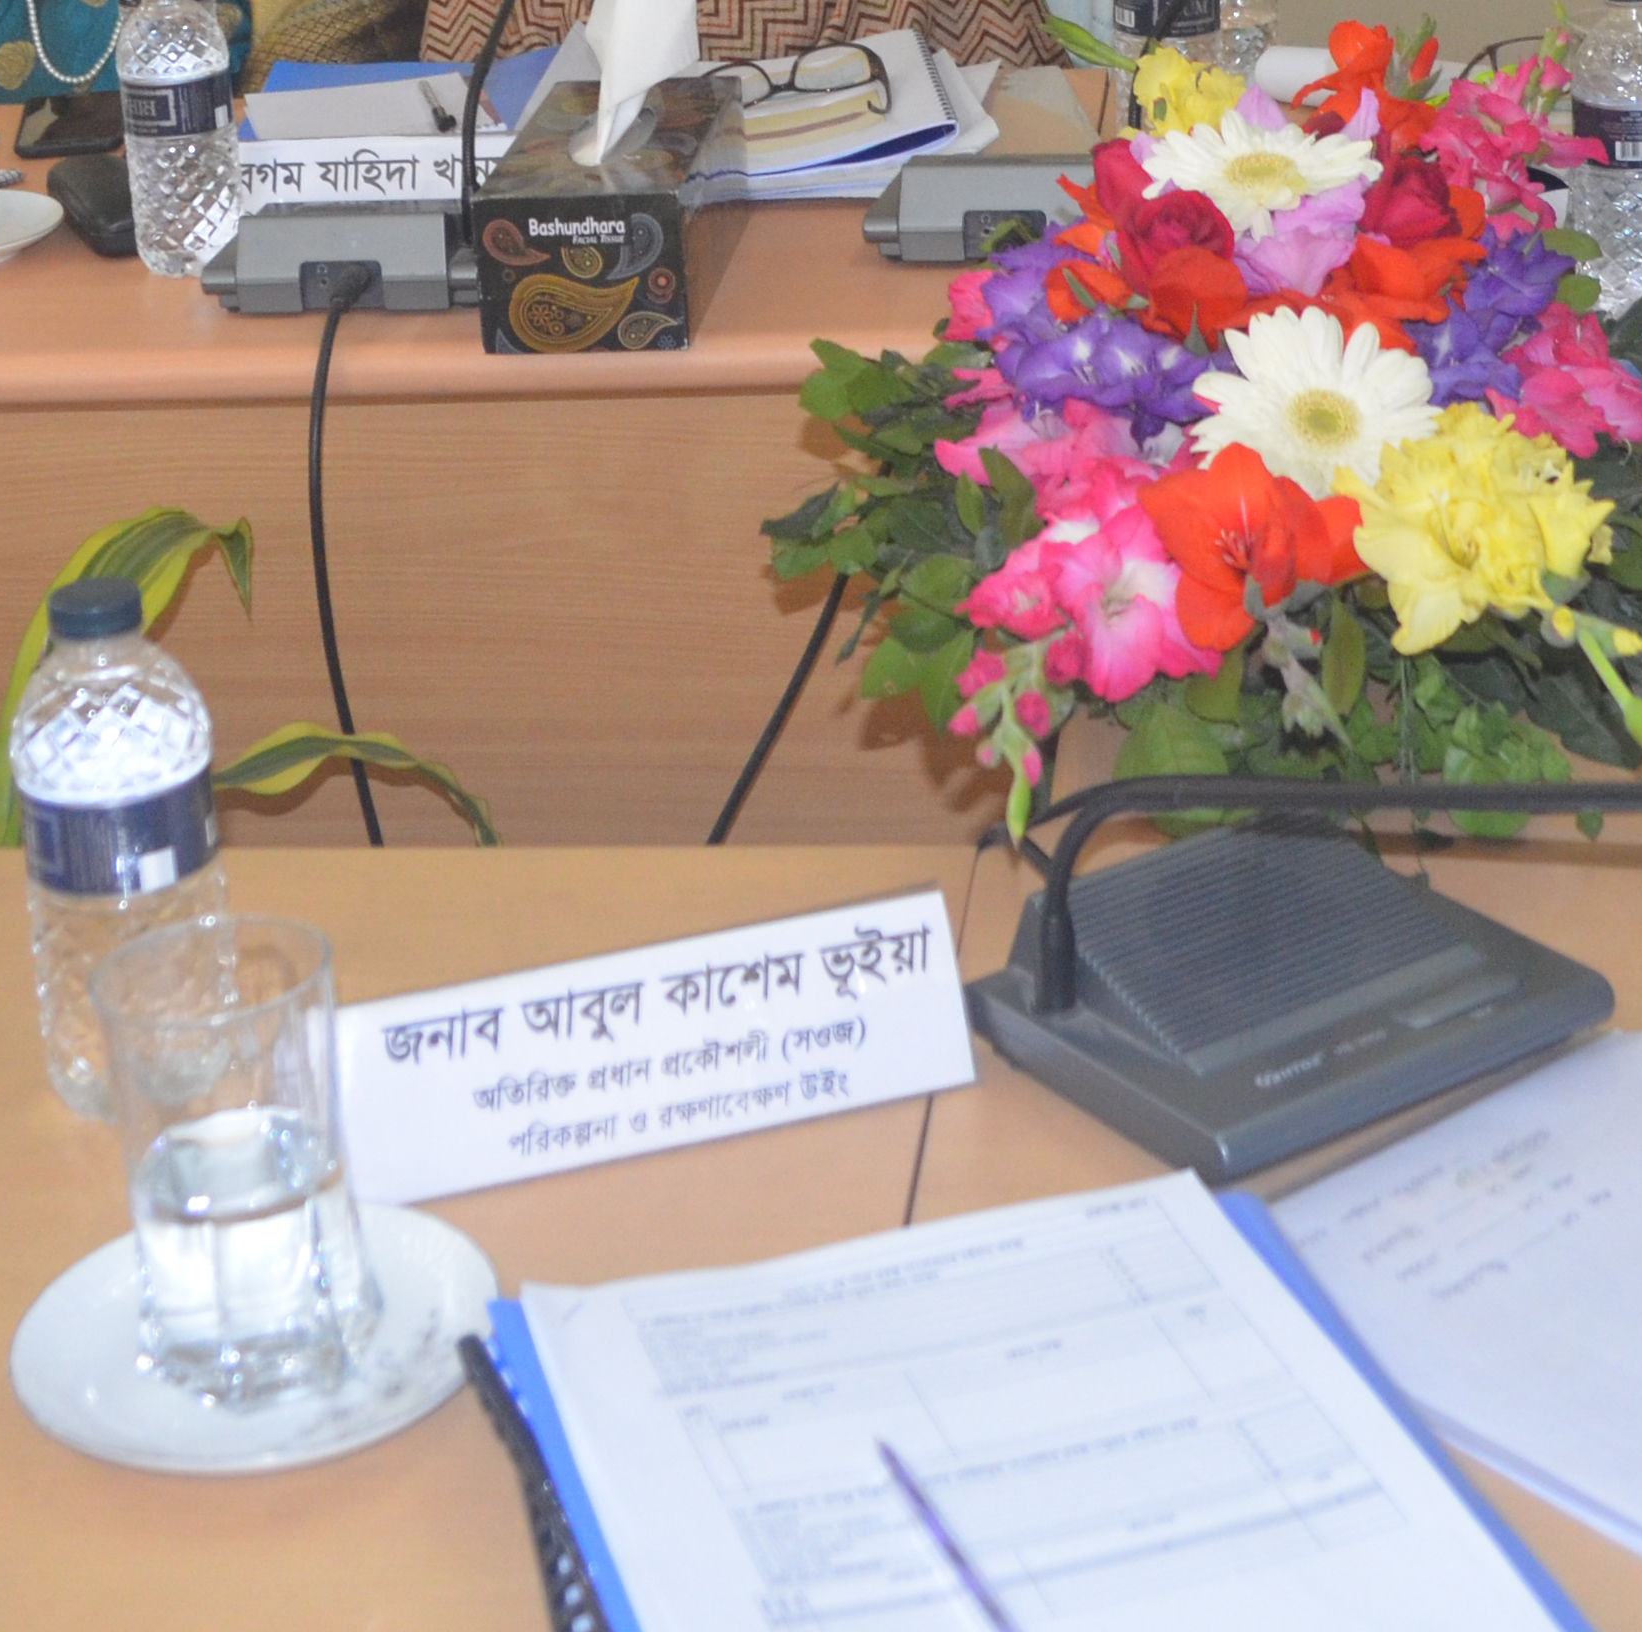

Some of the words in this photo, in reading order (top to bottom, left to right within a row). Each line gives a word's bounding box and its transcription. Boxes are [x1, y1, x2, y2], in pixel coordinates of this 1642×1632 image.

[315, 148, 420, 196] যাহিদা
[528, 216, 626, 237] Bashundhara
[381, 1005, 504, 1066] জনাব
[520, 981, 645, 1043] আবুল
[660, 950, 806, 1015] কাশেম
[473, 1069, 577, 1112] অতিরিক্ত
[587, 1056, 652, 1092] প্রধান
[660, 1029, 769, 1079] প্রকৌশলী
[629, 1111, 649, 1134] ও
